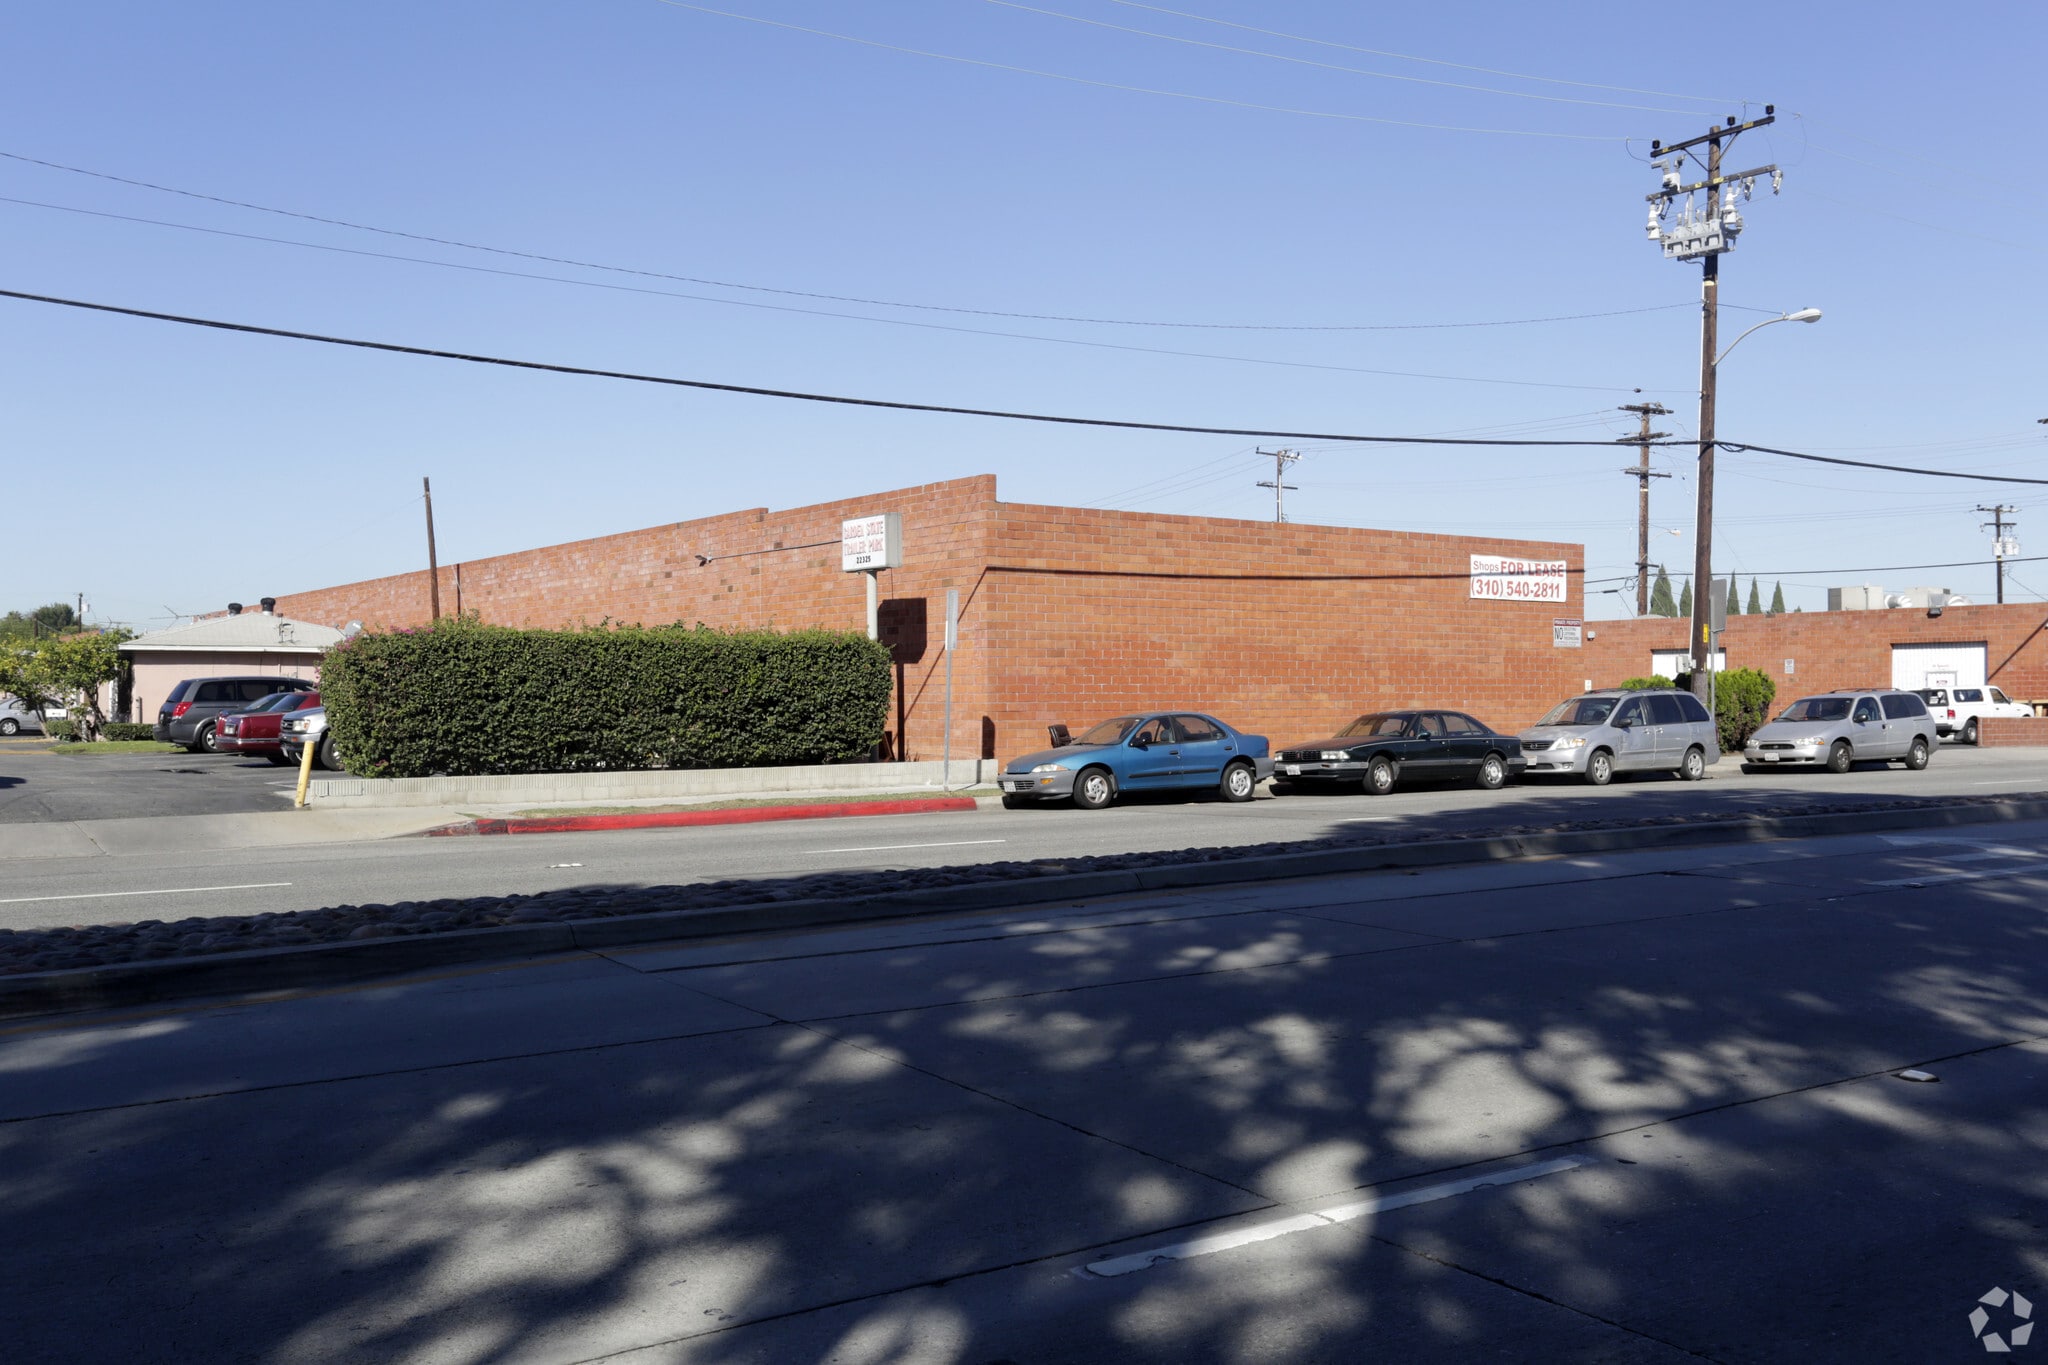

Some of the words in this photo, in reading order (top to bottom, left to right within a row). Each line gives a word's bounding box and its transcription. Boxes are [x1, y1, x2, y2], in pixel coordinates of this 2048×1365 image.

[1473, 560, 1499, 575] Shops
[1500, 561, 1524, 575] FOR
[1528, 563, 1564, 577] LEASE
[1471, 578, 1504, 597] (310)
[1506, 581, 1560, 598] 540-2811
